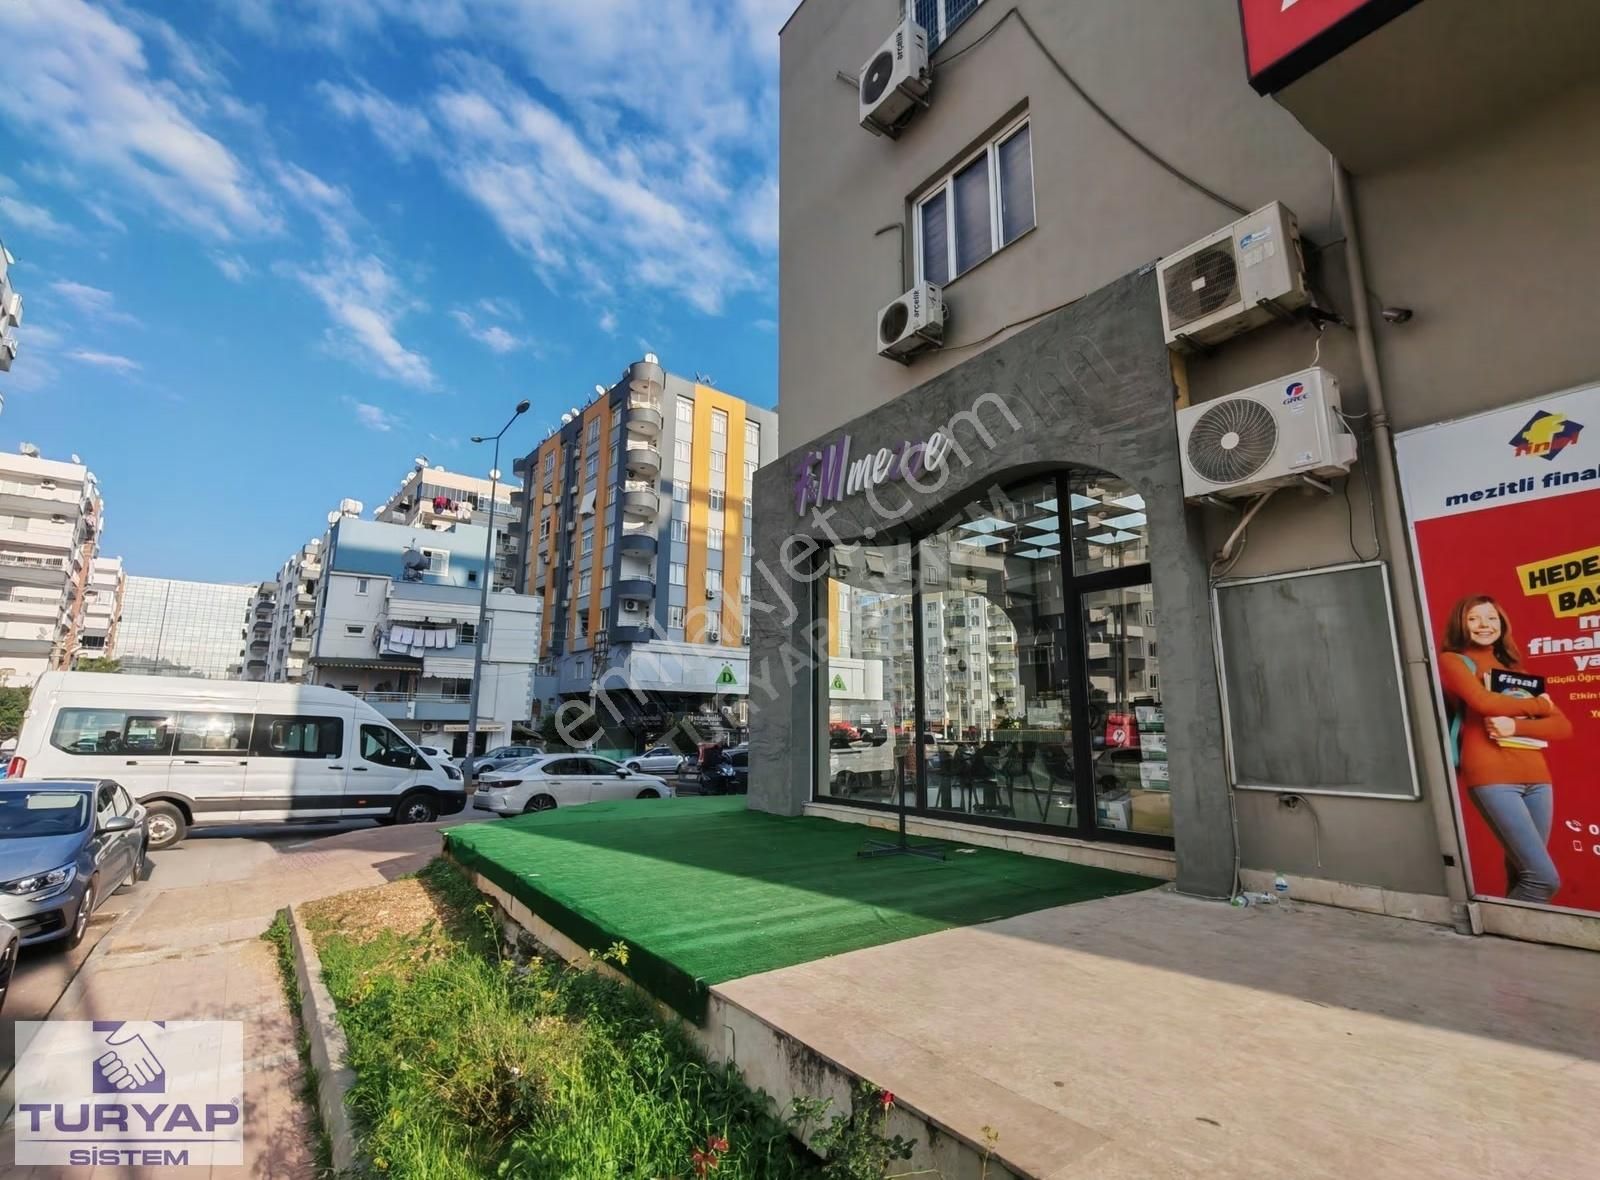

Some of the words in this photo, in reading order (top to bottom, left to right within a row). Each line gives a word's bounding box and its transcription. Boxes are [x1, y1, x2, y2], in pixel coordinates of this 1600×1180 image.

[1446, 477, 1534, 506] mezitli
[1529, 555, 1599, 589] HEDE
[1498, 674, 1538, 688] final
[1547, 674, 1576, 685] Güçlü
[1569, 692, 1597, 700] Etkin
